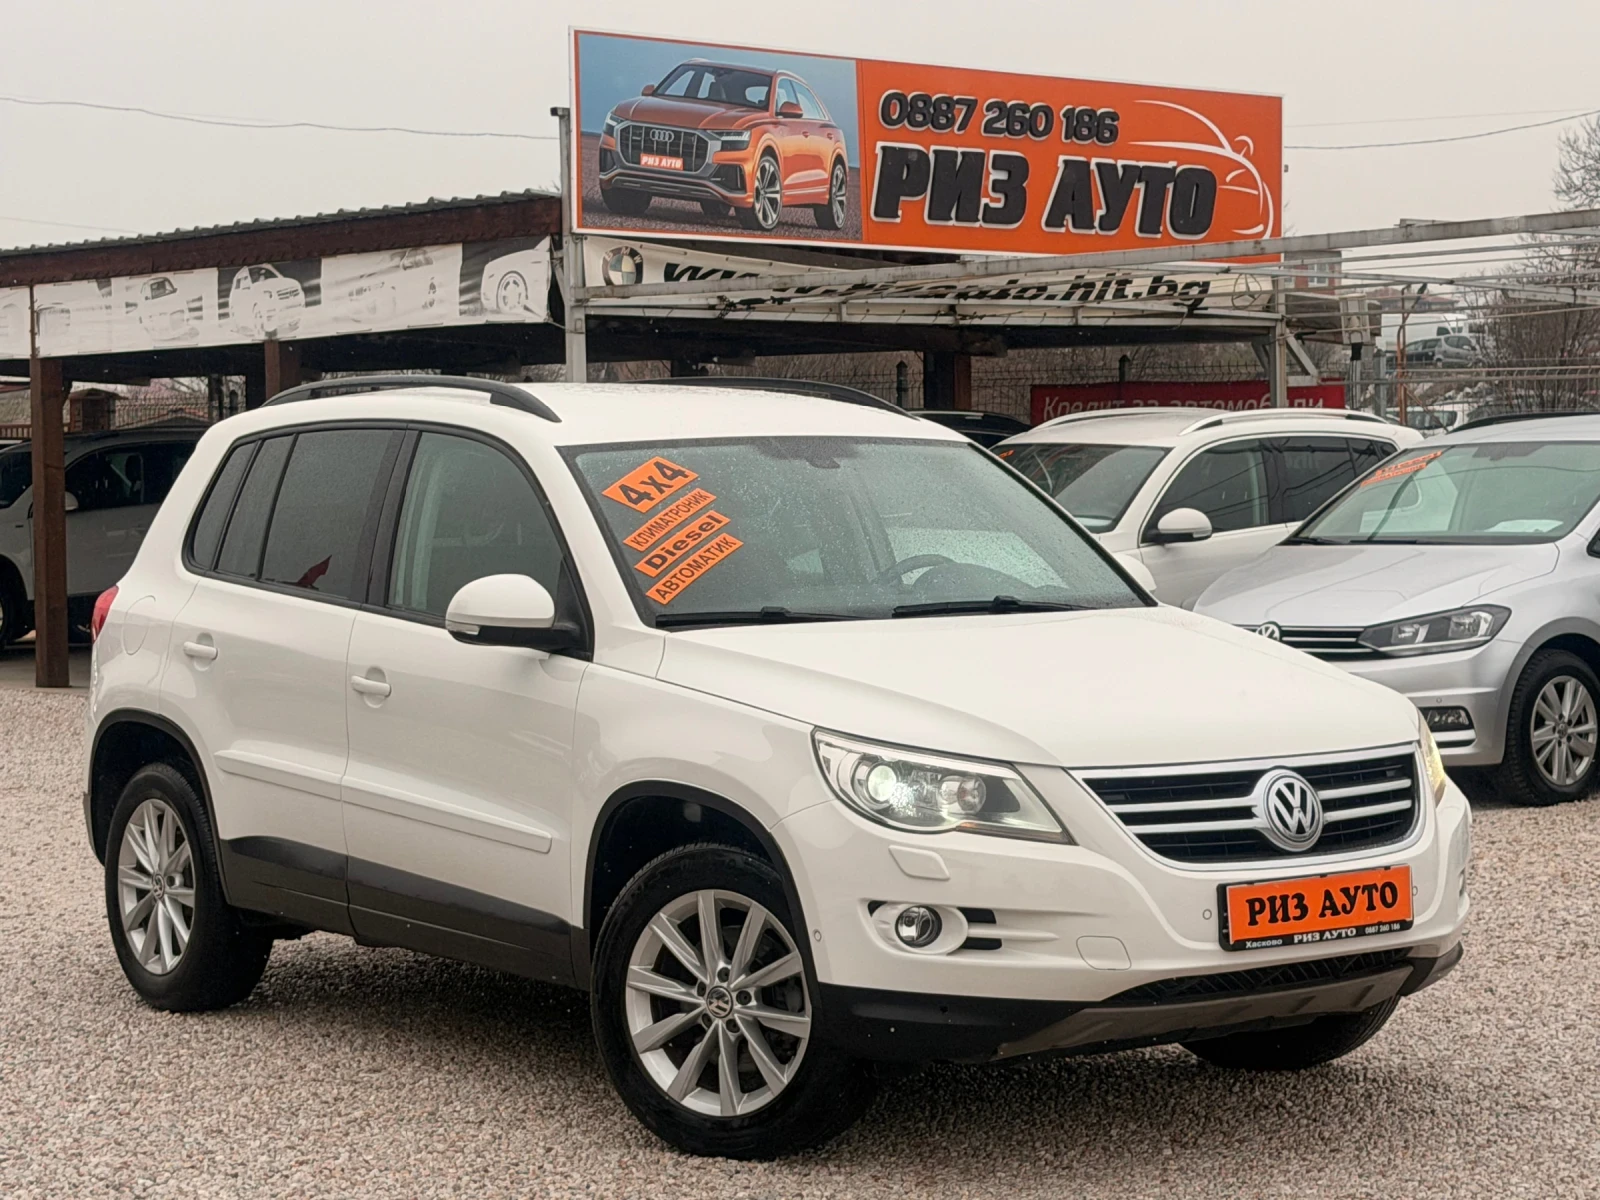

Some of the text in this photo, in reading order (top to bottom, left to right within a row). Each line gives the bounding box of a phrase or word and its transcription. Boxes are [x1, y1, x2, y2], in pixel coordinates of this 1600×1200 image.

[879, 89, 1120, 146] 0887 260 186
[871, 141, 1218, 240] РИЗ АУТО
[631, 491, 711, 547] КЛИМАТРОНИК
[644, 515, 723, 570] Diesel
[655, 537, 737, 600] АВТОМАТИК
[1246, 892, 1309, 926] РИЗ
[1318, 881, 1398, 918] АУТО
[1245, 938, 1283, 949] Хасково
[1293, 932, 1320, 944] РИЗ
[1322, 927, 1357, 940] АУТО
